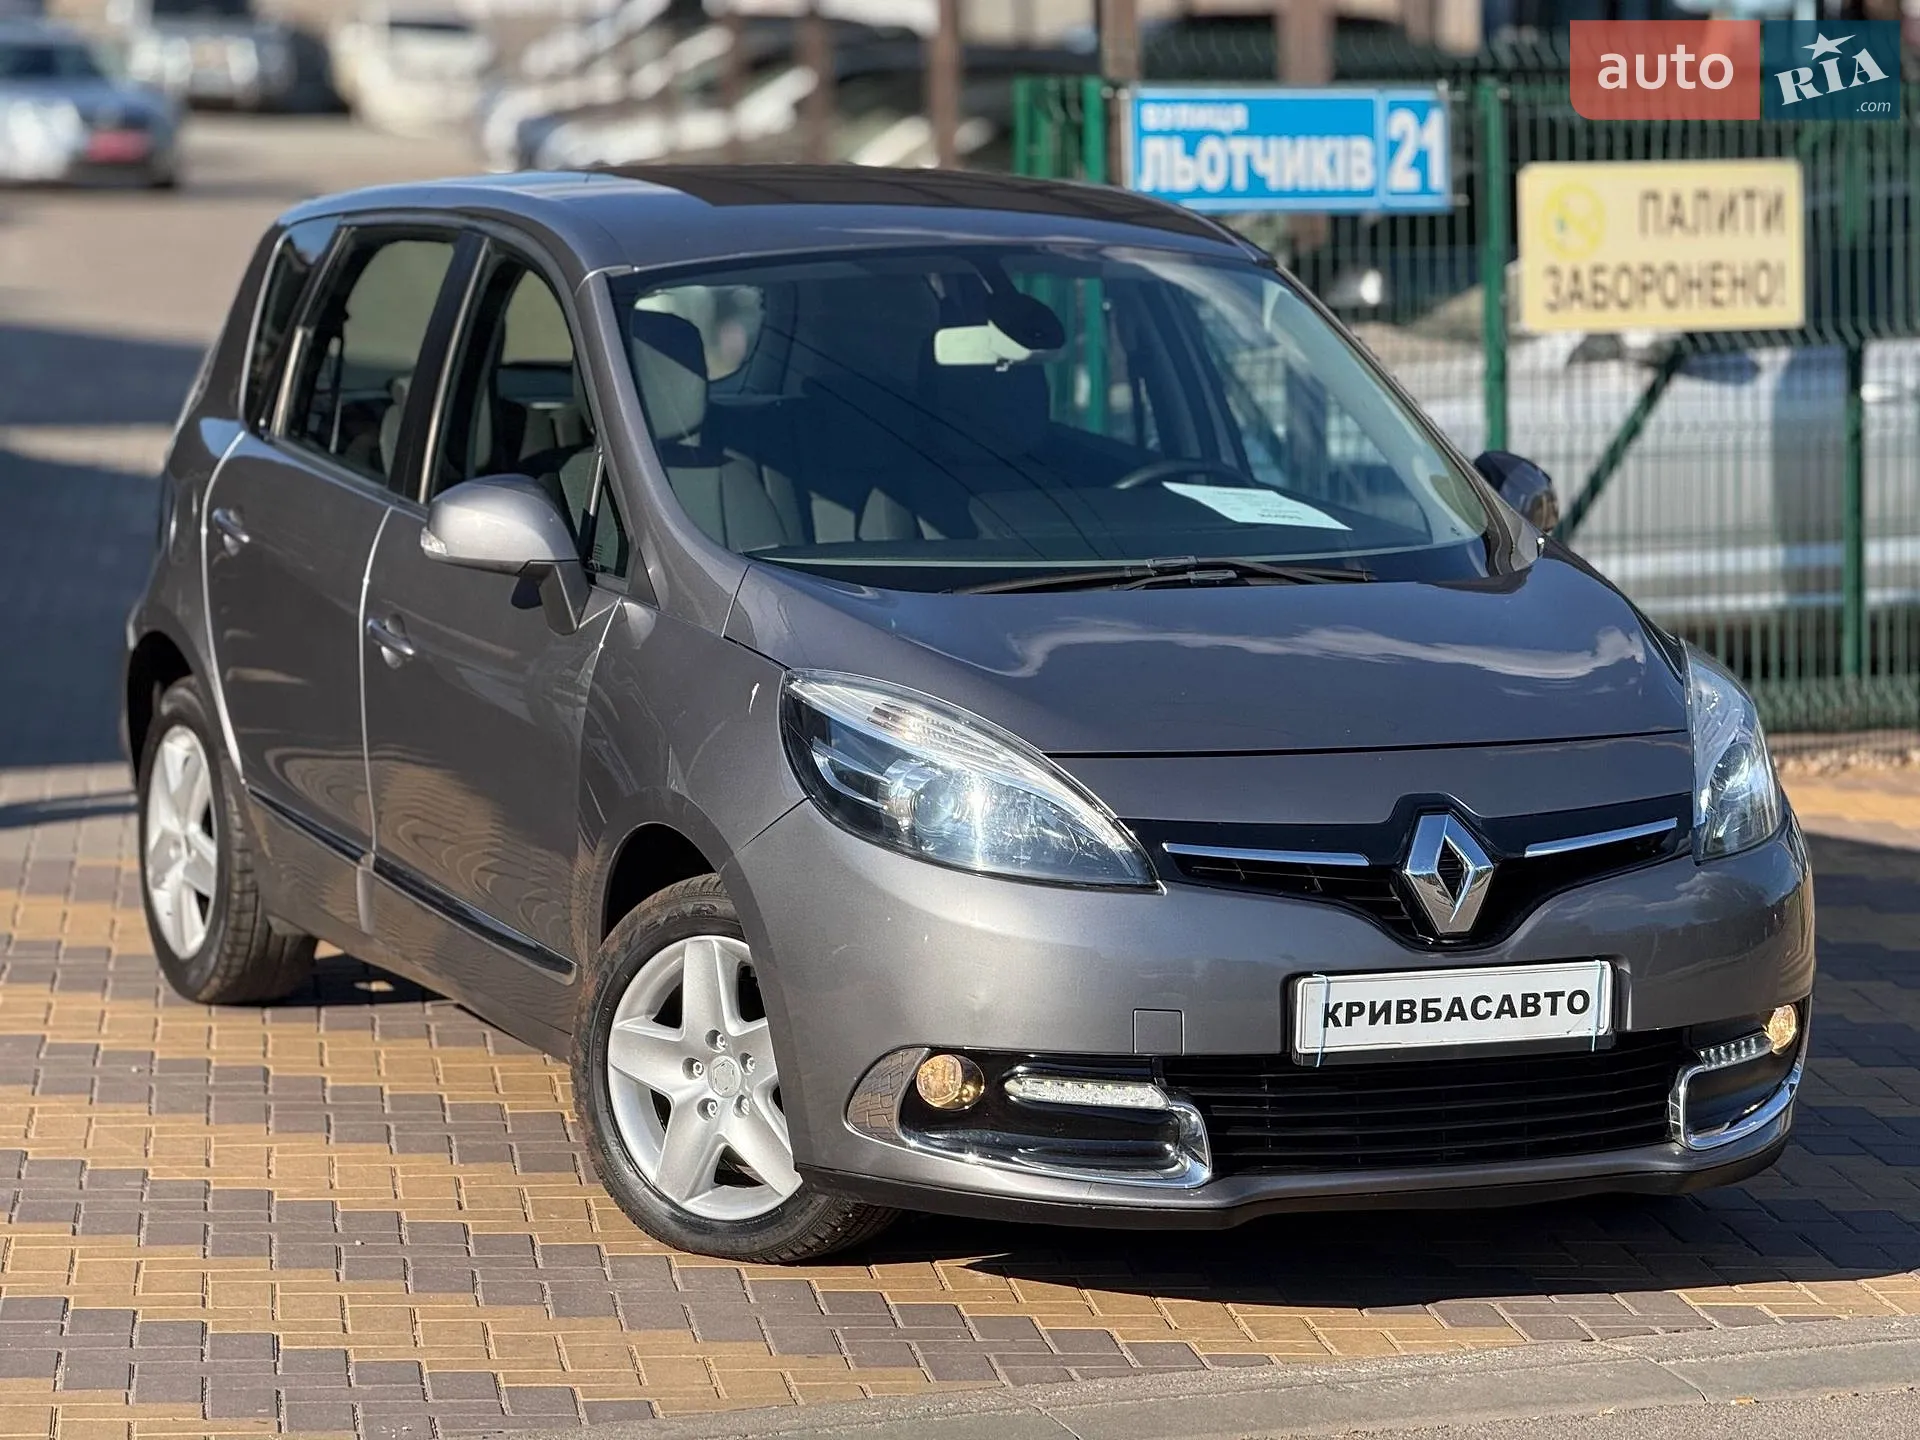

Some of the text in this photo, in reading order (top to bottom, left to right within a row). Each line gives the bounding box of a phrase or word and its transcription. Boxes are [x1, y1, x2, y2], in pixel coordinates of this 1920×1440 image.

[1141, 108, 1446, 192] ЛЬОТЧИКІВ 21
[1638, 188, 1787, 236] ПАЛИТИ
[1543, 258, 1788, 312] ЗАБОРОНЕНО!
[1323, 989, 1591, 1028] КРИВБАСАВТО
